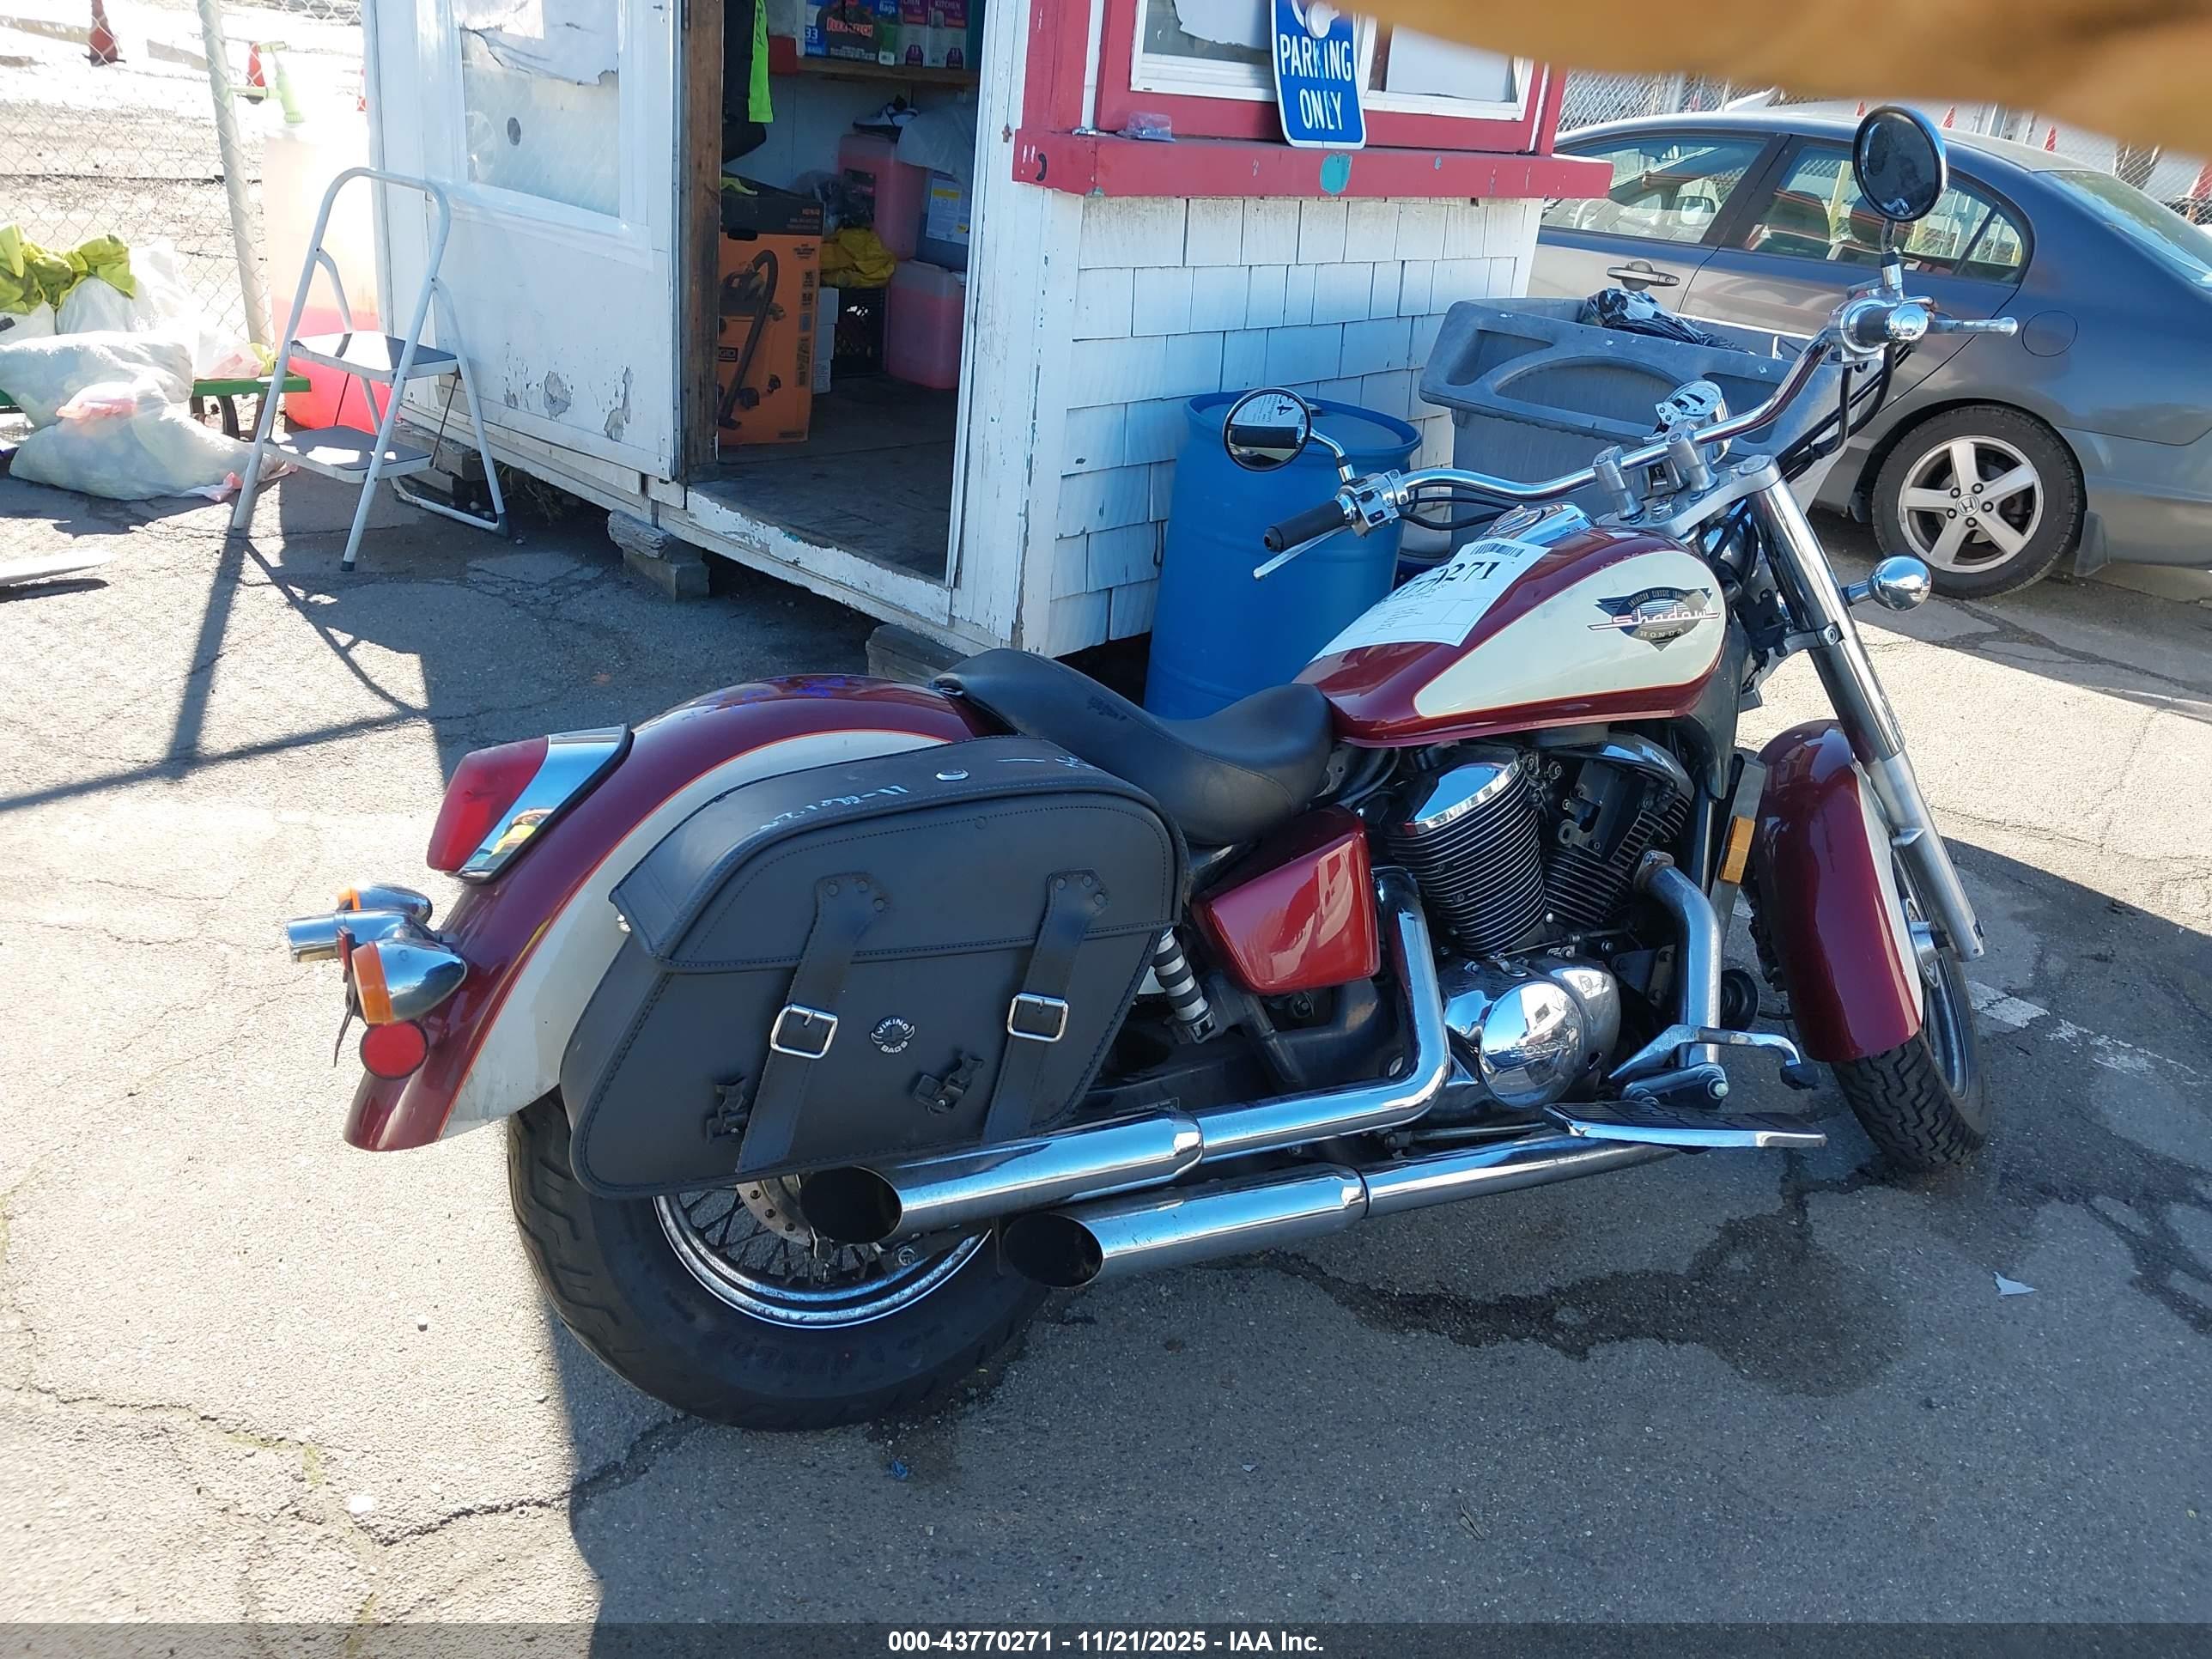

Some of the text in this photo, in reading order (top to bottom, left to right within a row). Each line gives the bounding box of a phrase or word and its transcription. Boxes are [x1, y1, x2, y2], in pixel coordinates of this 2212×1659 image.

[1279, 33, 1352, 82] PARKING
[1299, 89, 1343, 131] ONLY
[1639, 628, 1684, 638] HONDA
[877, 1018, 909, 1034] VIKING
[880, 1041, 908, 1054] BAGS
